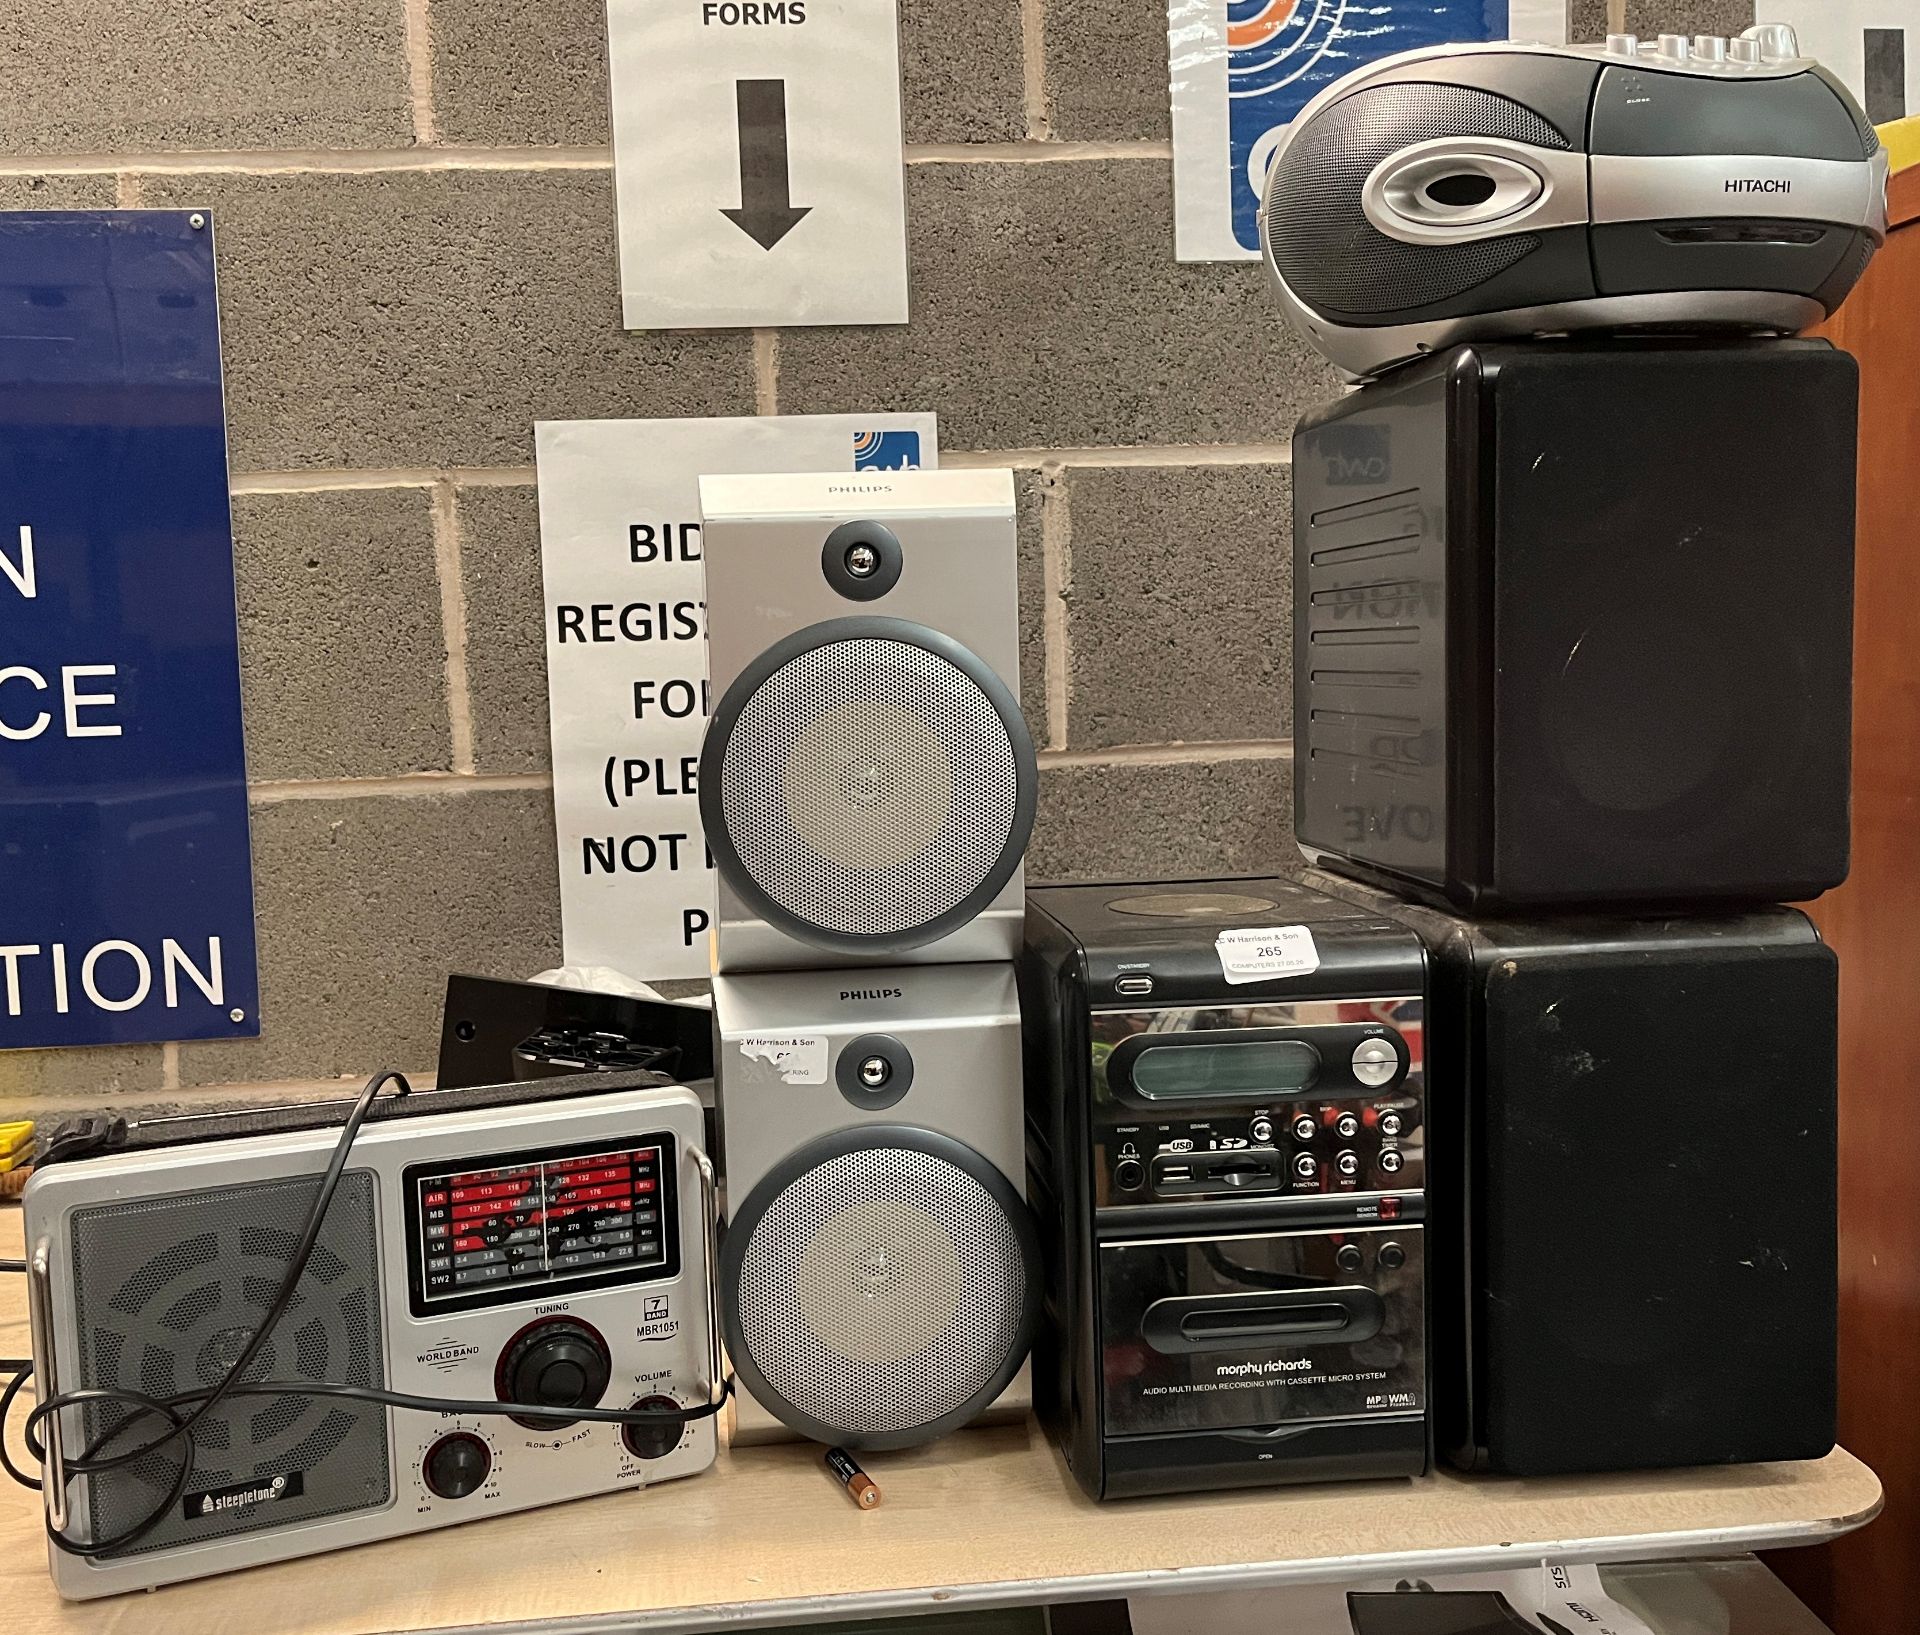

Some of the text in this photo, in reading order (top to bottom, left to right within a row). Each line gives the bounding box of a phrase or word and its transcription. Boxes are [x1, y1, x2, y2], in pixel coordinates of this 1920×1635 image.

[703, 2, 806, 25] FORMS
[1725, 180, 1790, 193] HITACHI
[829, 485, 892, 493] PHILIPS
[557, 601, 706, 643] REGIS
[0, 664, 122, 740] CE
[634, 679, 708, 719] FO
[583, 834, 687, 875] NOT
[684, 909, 709, 946] P
[1256, 946, 1282, 957] 265
[840, 988, 902, 1001] PHILIPS
[1172, 1141, 1192, 1150] USB
[428, 1193, 443, 1202] AIR
[429, 1210, 443, 1218] MB
[430, 1226, 445, 1235] MW
[587, 1204, 598, 1212] 120
[432, 1242, 444, 1251] LW
[567, 1222, 579, 1231] 270
[431, 1258, 449, 1267] SW1
[431, 1274, 450, 1284] SW2
[534, 1302, 569, 1315] TUNING
[651, 1299, 661, 1310] 7
[646, 1311, 667, 1320] BAND
[636, 1320, 679, 1337] MBR1051
[416, 1346, 479, 1363] WORLD BAND
[1217, 1358, 1312, 1376] morphy richards
[634, 1369, 672, 1383] VOLUME
[1142, 1372, 1386, 1395] AUDIO MULTI MEDIA RECORDING WITH CASSETTE MICRO SYSTEM
[572, 1428, 592, 1443] FAST
[616, 1469, 641, 1478] POWER
[621, 1463, 634, 1471] OFF
[215, 1487, 276, 1510] steepletone
